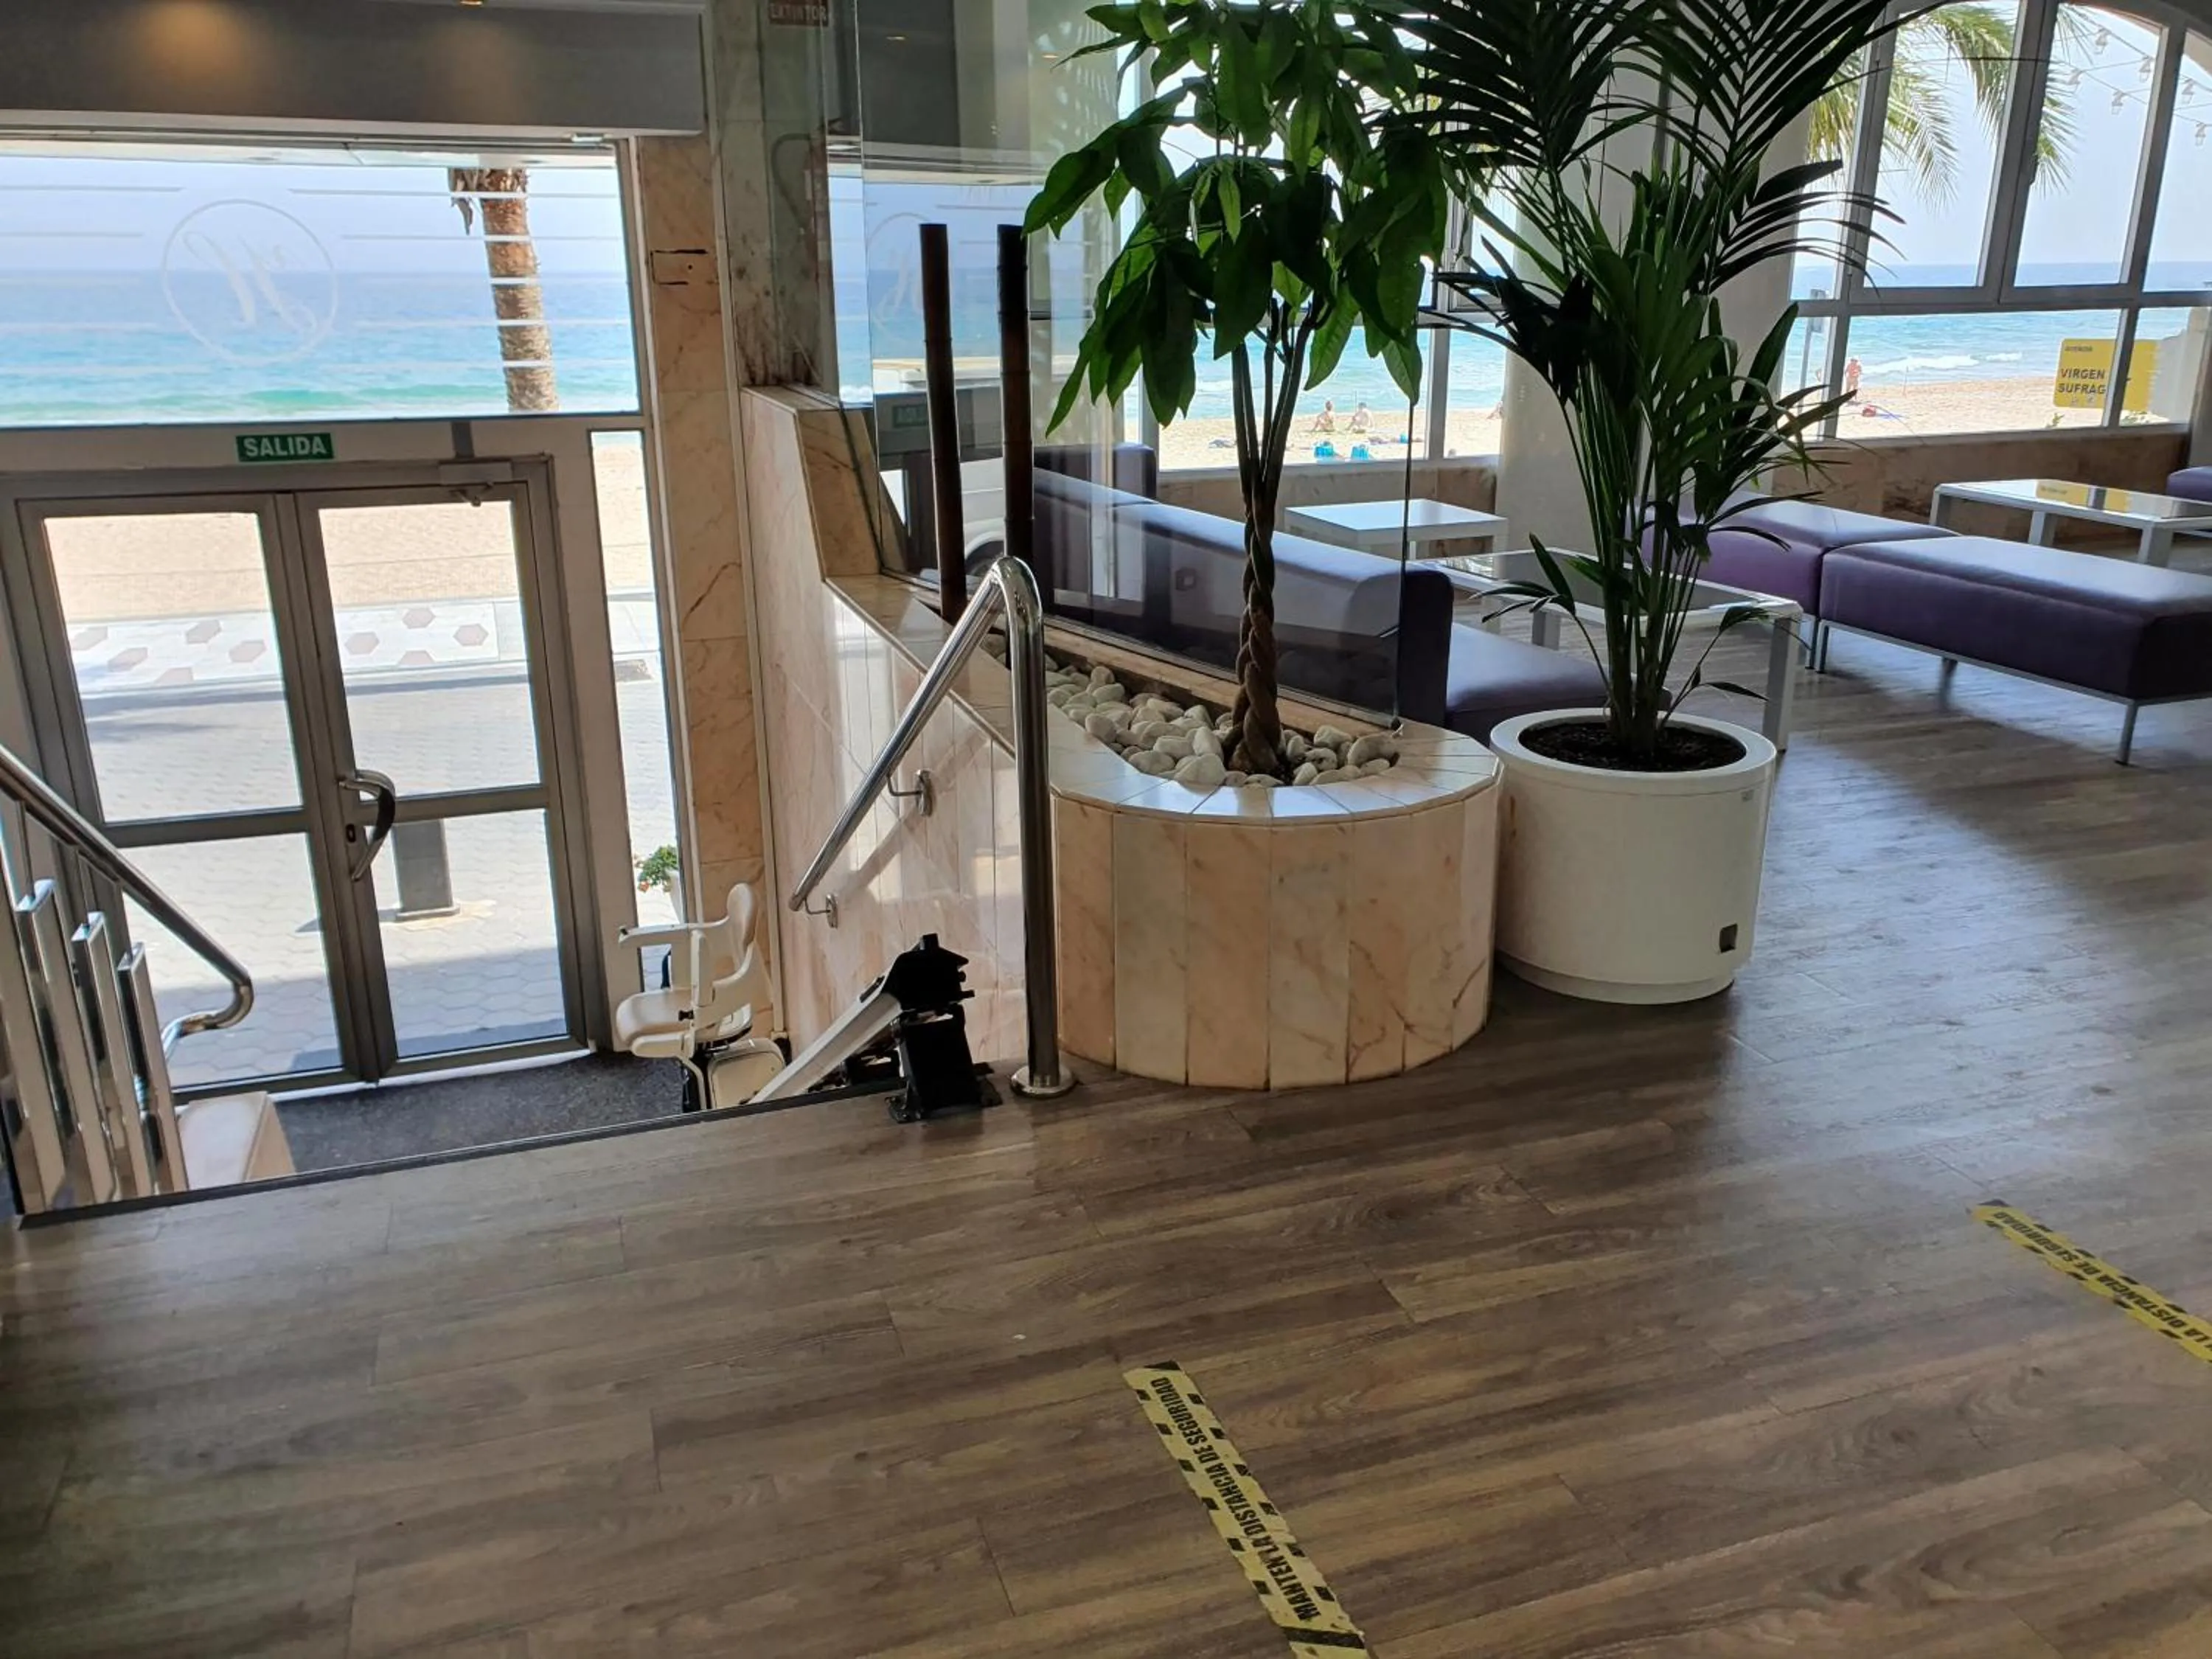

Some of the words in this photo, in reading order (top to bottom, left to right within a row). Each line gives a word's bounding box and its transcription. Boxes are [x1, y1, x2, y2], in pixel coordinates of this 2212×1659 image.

[2059, 367, 2106, 380] VIRGEN
[243, 436, 327, 457] SALIDA
[1993, 1211, 2079, 1262] SEGURIDAD
[2074, 1261, 2101, 1275] DE
[2096, 1275, 2189, 1329] DISTANCIA
[1150, 1377, 1208, 1446] SEGURIDAD
[1192, 1444, 1220, 1464] DE
[1205, 1462, 1267, 1536] DISTANCIA
[1251, 1535, 1280, 1556] LA
[1262, 1555, 1322, 1621] MANTEN
